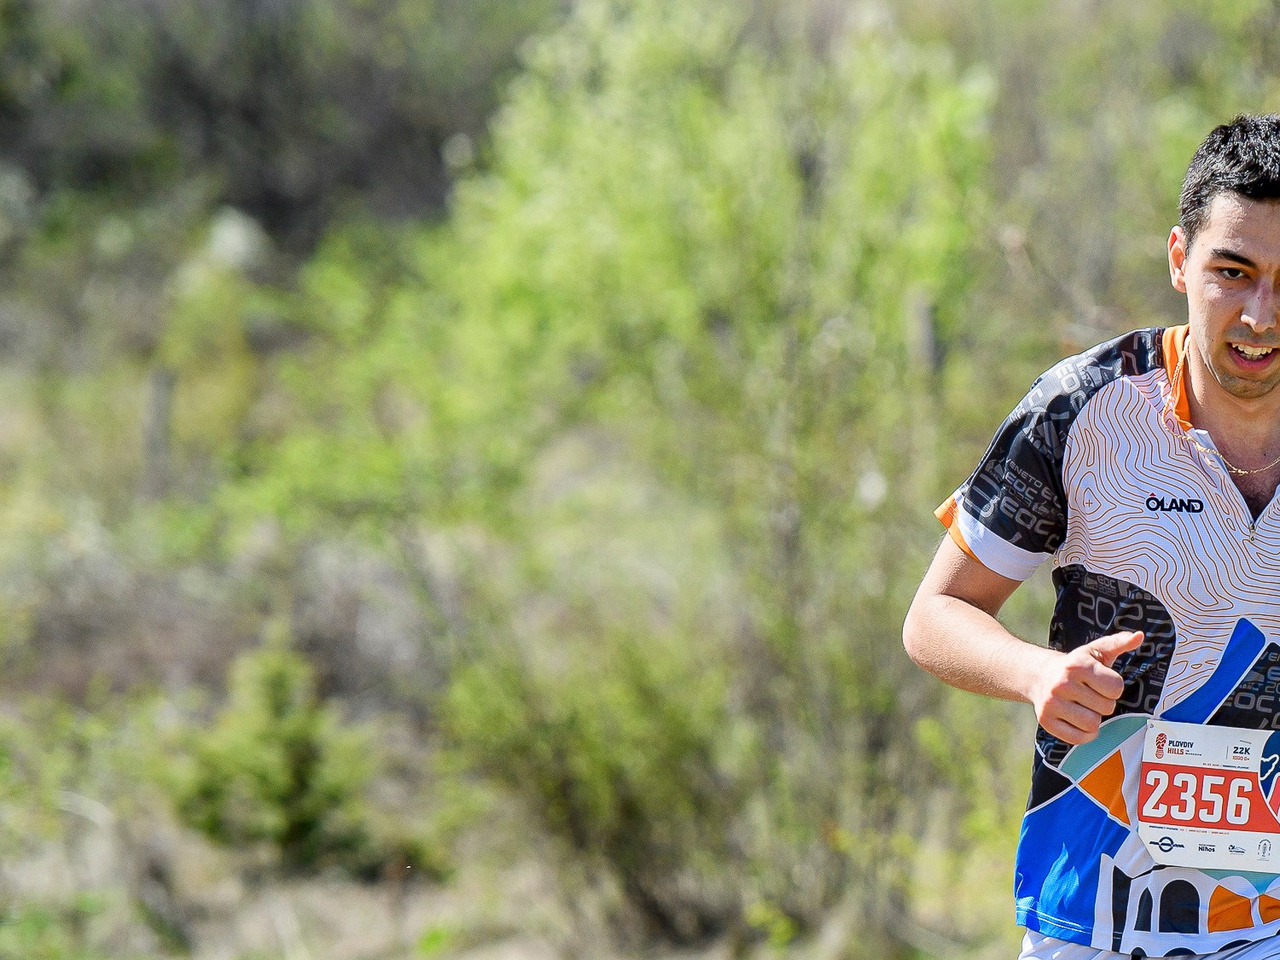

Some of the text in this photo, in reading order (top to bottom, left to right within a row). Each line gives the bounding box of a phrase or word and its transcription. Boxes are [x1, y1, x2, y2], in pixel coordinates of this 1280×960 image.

[1005, 457, 1043, 488] VENETO
[1000, 495, 1056, 536] EOC
[1168, 740, 1194, 748] PLOVDIV
[1233, 746, 1251, 755] 22K
[1142, 769, 1253, 825] 2356
